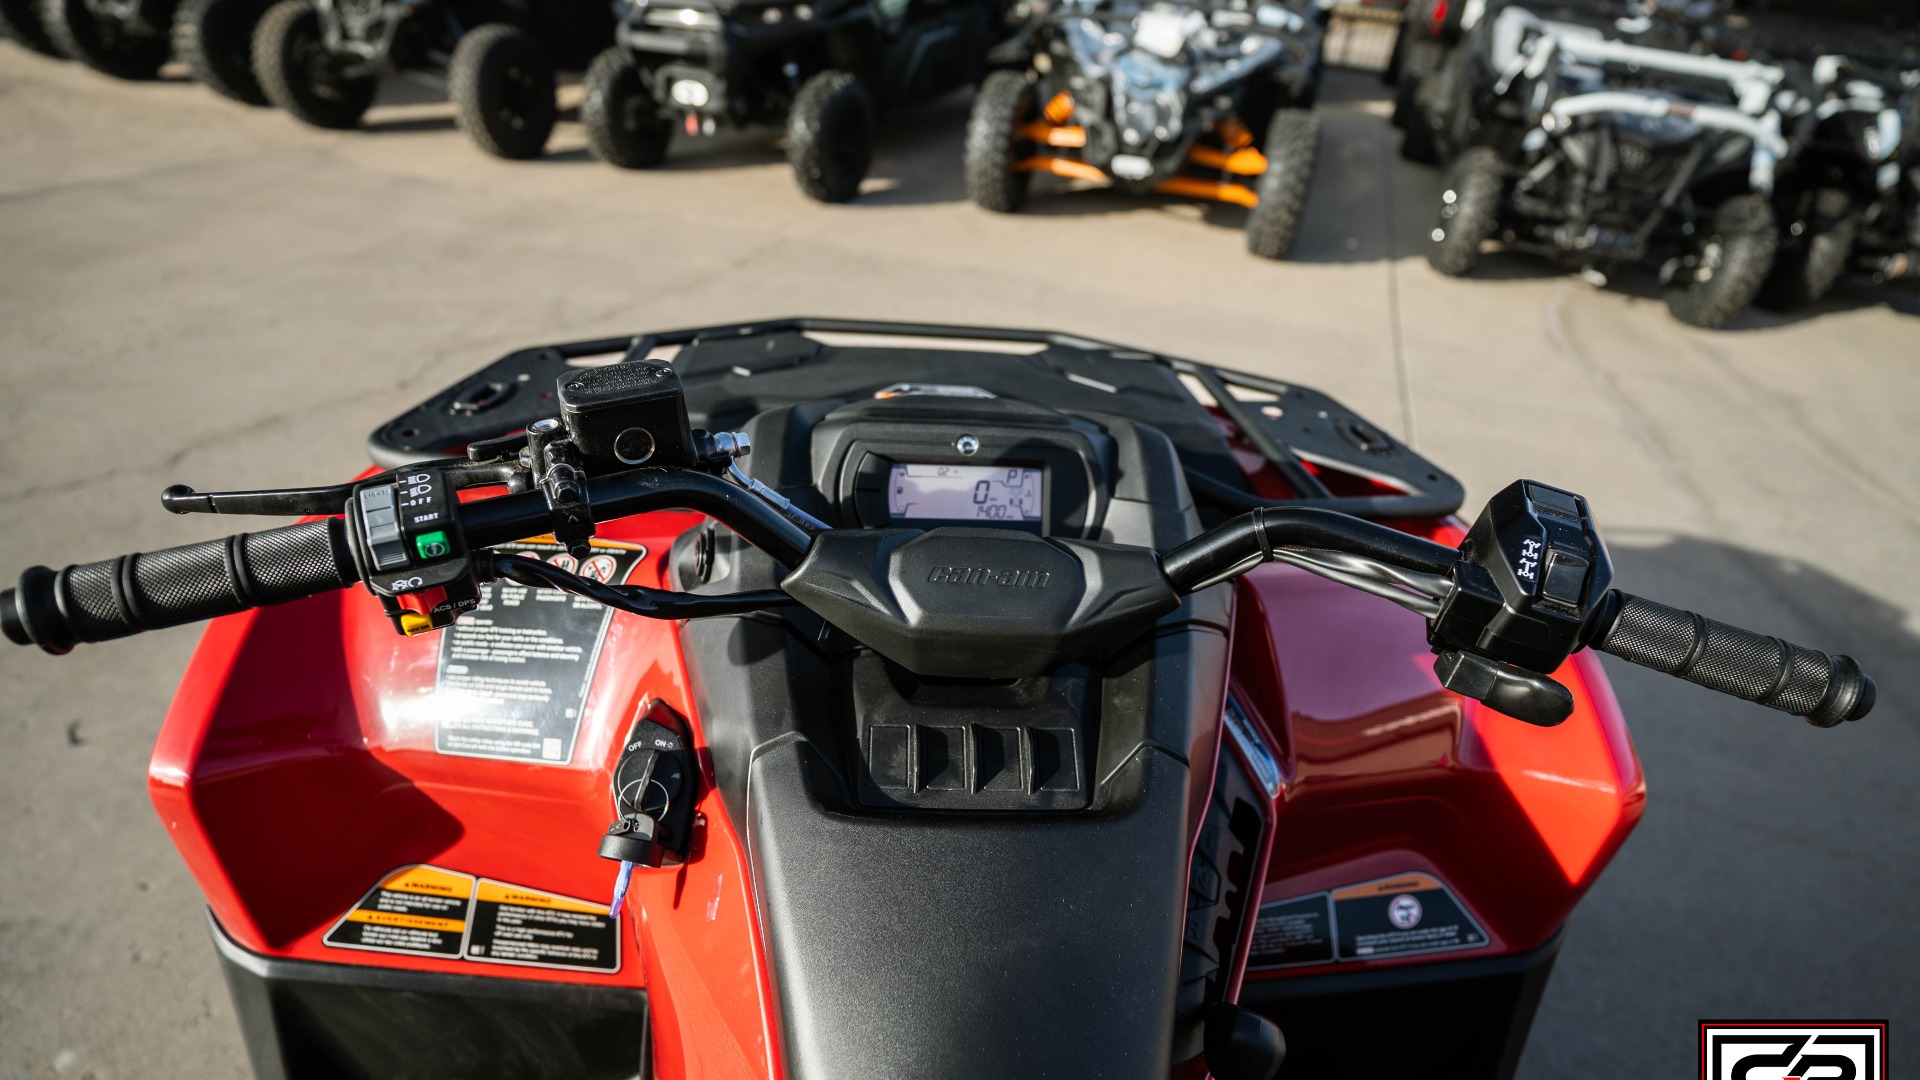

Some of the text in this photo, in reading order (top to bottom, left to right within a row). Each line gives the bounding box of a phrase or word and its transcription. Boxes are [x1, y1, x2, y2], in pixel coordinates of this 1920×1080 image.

[1006, 469, 1018, 484] P
[973, 480, 990, 504] 0
[410, 496, 432, 506] OFF
[414, 512, 439, 523] START
[927, 566, 1050, 588] can-am
[433, 603, 452, 614] ACS
[457, 598, 476, 608] DPS
[628, 738, 667, 752] OFF ON
